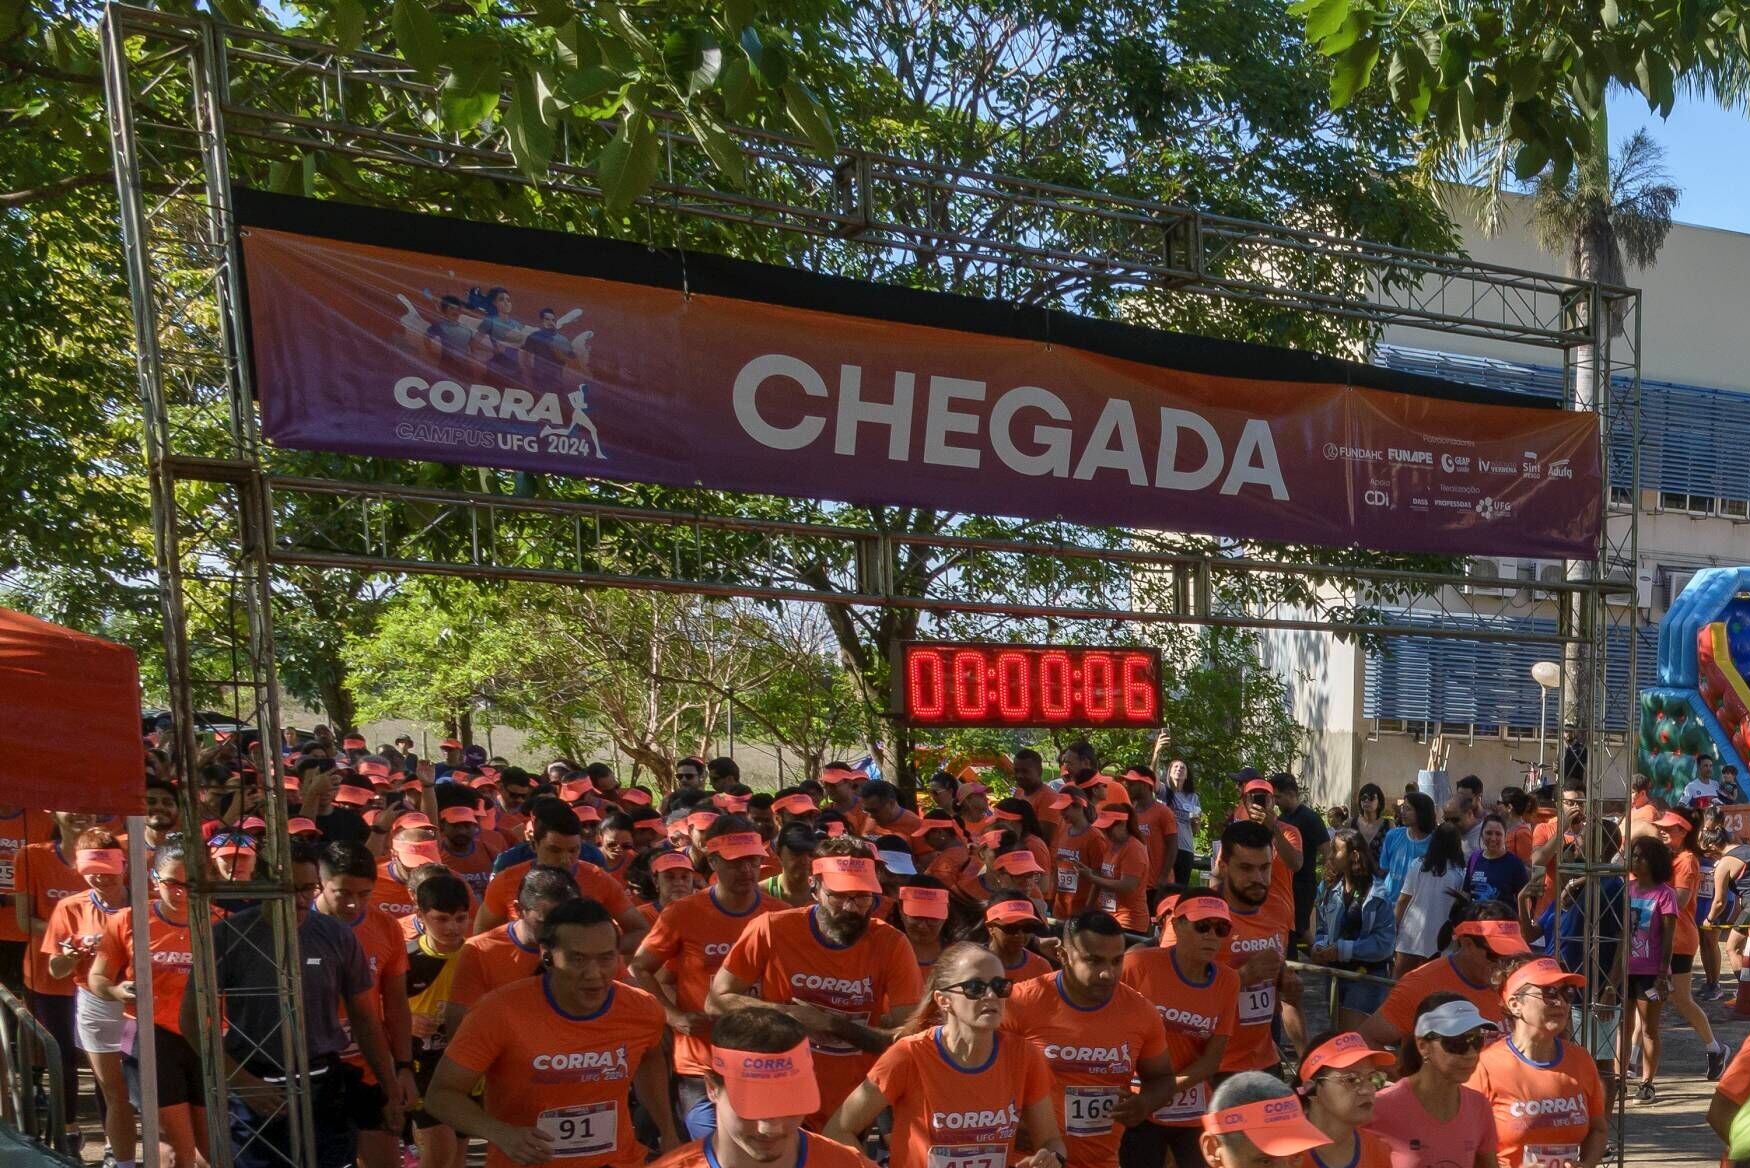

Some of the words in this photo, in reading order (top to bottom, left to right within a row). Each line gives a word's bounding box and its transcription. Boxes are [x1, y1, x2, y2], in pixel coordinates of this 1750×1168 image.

[393, 376, 563, 424] CORRA
[732, 353, 1290, 501] CHEGADA
[396, 423, 495, 448] CAMPUS
[497, 433, 538, 452] UFG
[548, 435, 589, 456] 2024
[1339, 446, 1383, 461] FUNDAHC
[1388, 447, 1434, 464] FUNAPE
[1369, 478, 1391, 487] Apoio
[1493, 501, 1512, 511] UFG
[909, 651, 1154, 718] 00:00:06
[1724, 814, 1743, 832] 23
[379, 902, 417, 913] COR
[1230, 937, 1276, 953] CORRA
[151, 951, 193, 964] ORR
[791, 973, 863, 994] CORRA
[1250, 991, 1270, 1011] 10
[1155, 1005, 1212, 1030] CORRA
[533, 1051, 613, 1070] CORRA
[1044, 1044, 1120, 1062] CORRA
[743, 1057, 793, 1070] CORRA
[1089, 1066, 1107, 1074] UFG
[1072, 1099, 1114, 1120] 169
[1511, 1098, 1578, 1117] CORRA
[560, 1118, 594, 1140] 91
[933, 1110, 1007, 1129] CORRA
